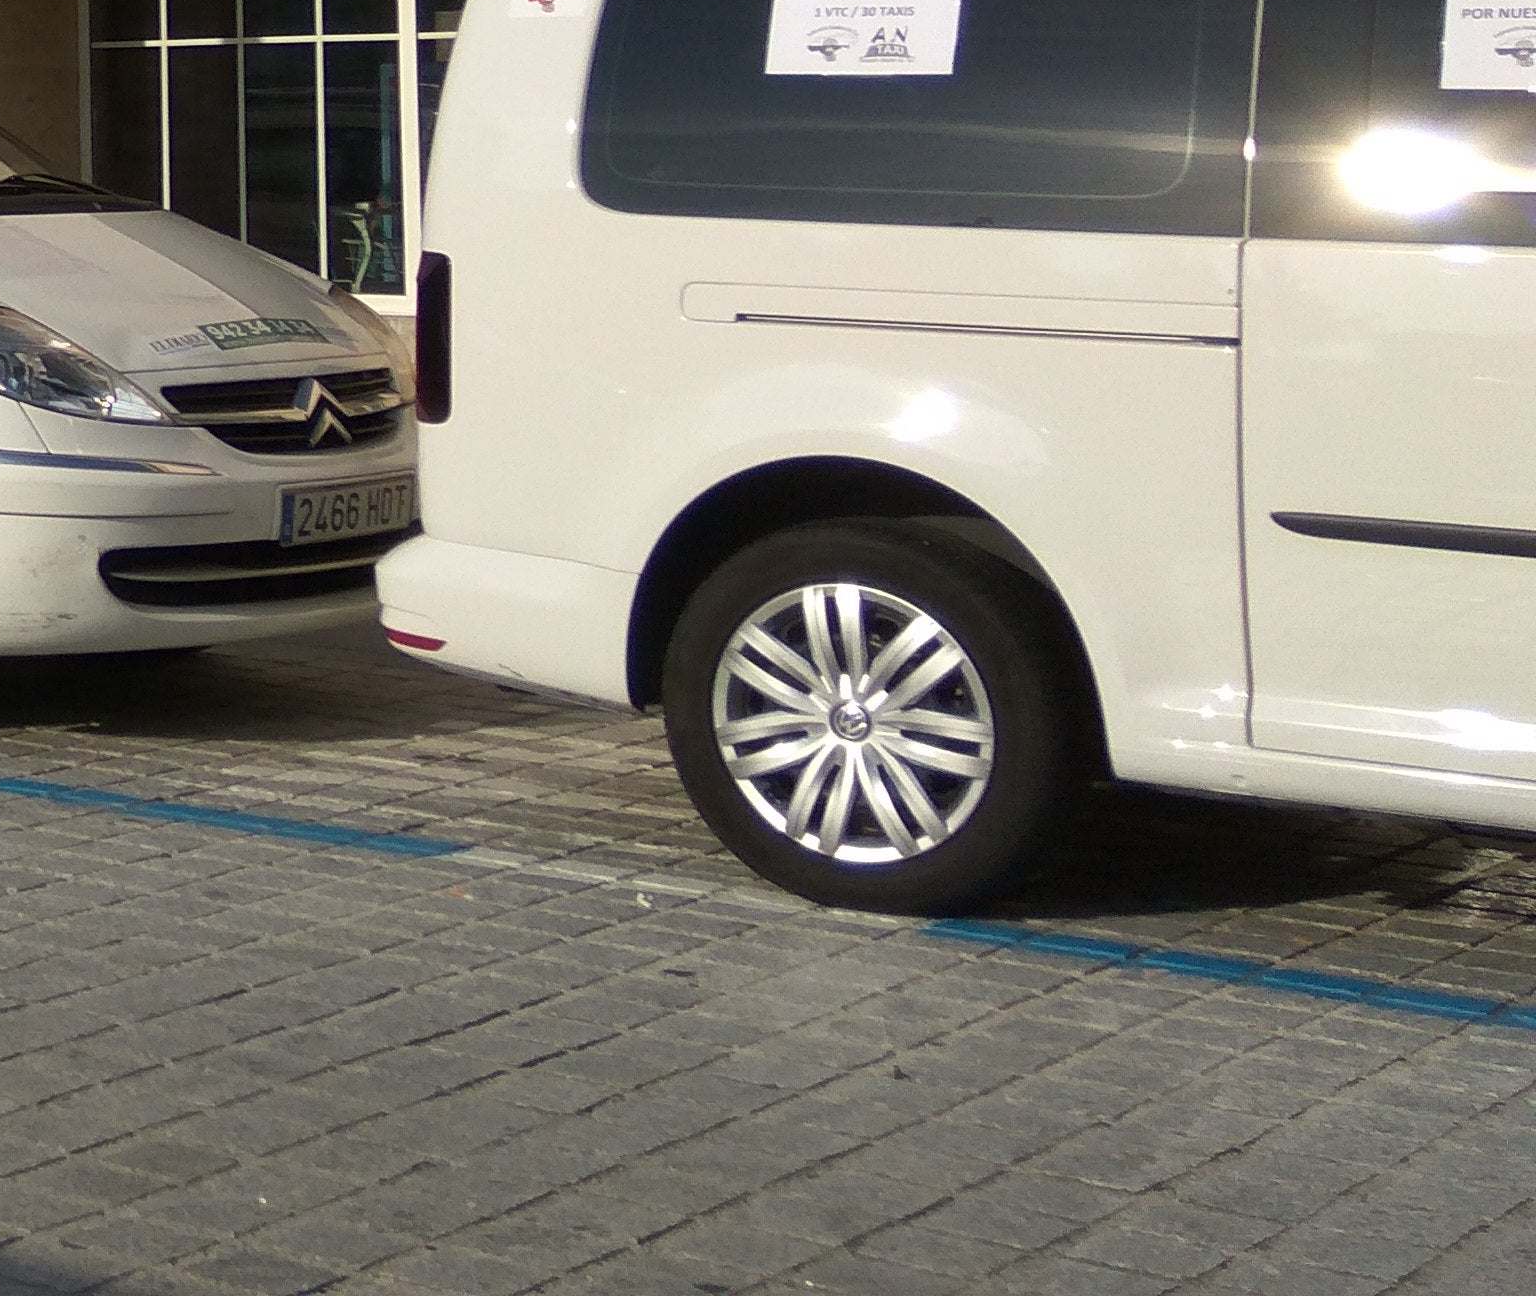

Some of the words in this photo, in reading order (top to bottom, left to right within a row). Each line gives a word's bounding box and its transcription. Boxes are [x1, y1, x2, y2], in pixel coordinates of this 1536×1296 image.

[814, 7, 821, 17] 1
[825, 7, 848, 17] VTC
[861, 6, 877, 17] 30
[880, 6, 915, 17] TAXIS
[1461, 8, 1494, 19] POR
[206, 323, 247, 340] 942
[246, 319, 271, 335] 34
[296, 493, 359, 538] 2466
[367, 484, 408, 526] HDT
